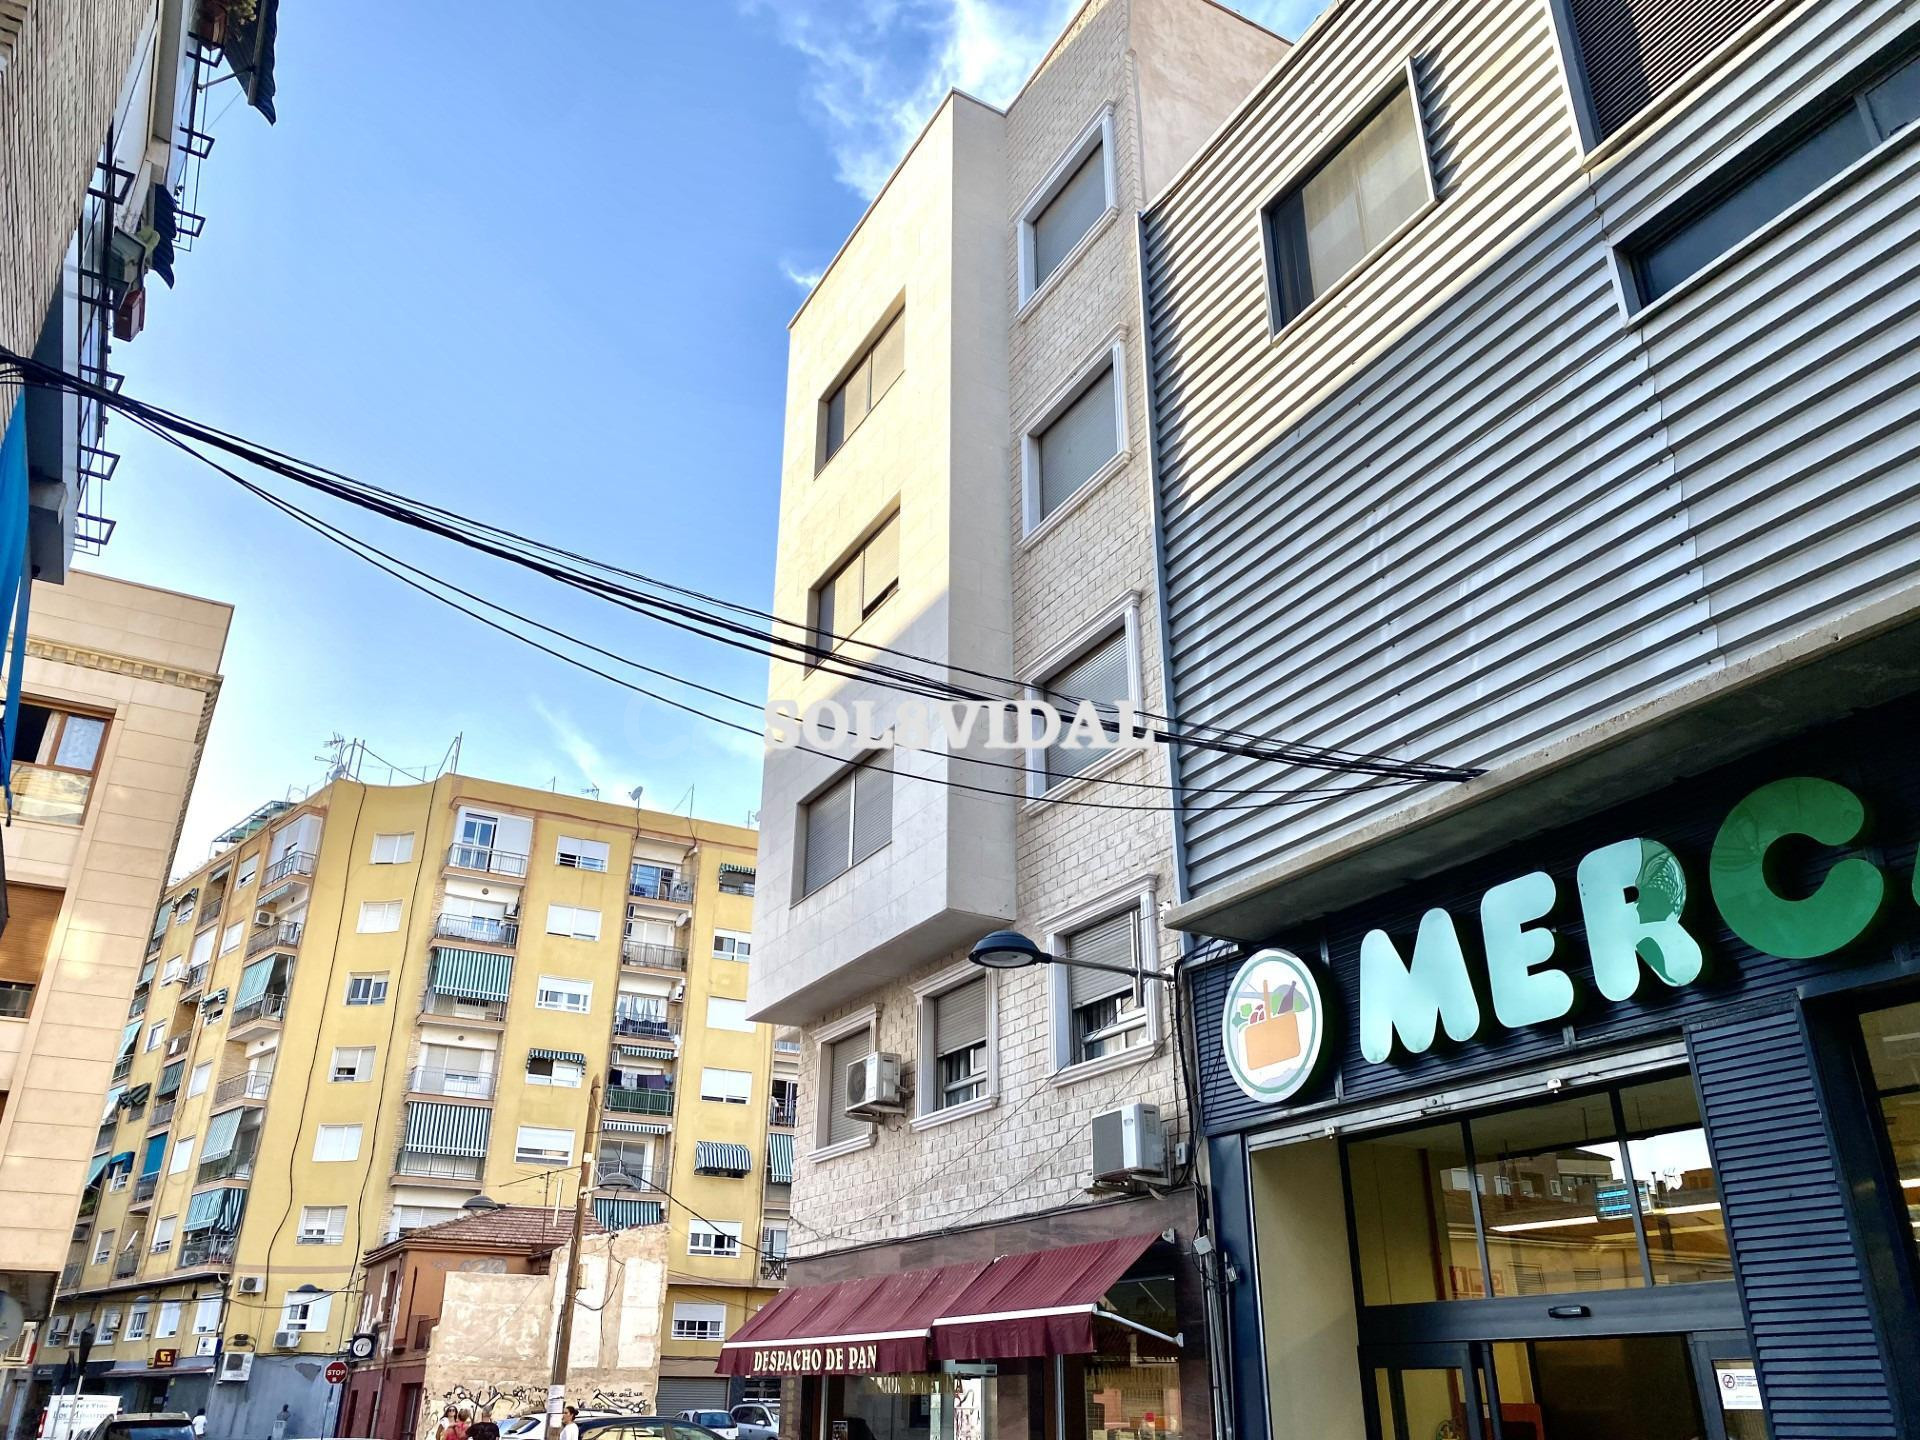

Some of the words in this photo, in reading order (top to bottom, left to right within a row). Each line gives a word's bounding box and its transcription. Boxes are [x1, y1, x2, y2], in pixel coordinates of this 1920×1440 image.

[1359, 776, 1920, 1025] MERC
[753, 1348, 822, 1372] DESPACHO
[824, 1347, 844, 1371] DE
[848, 1344, 877, 1370] PAN
